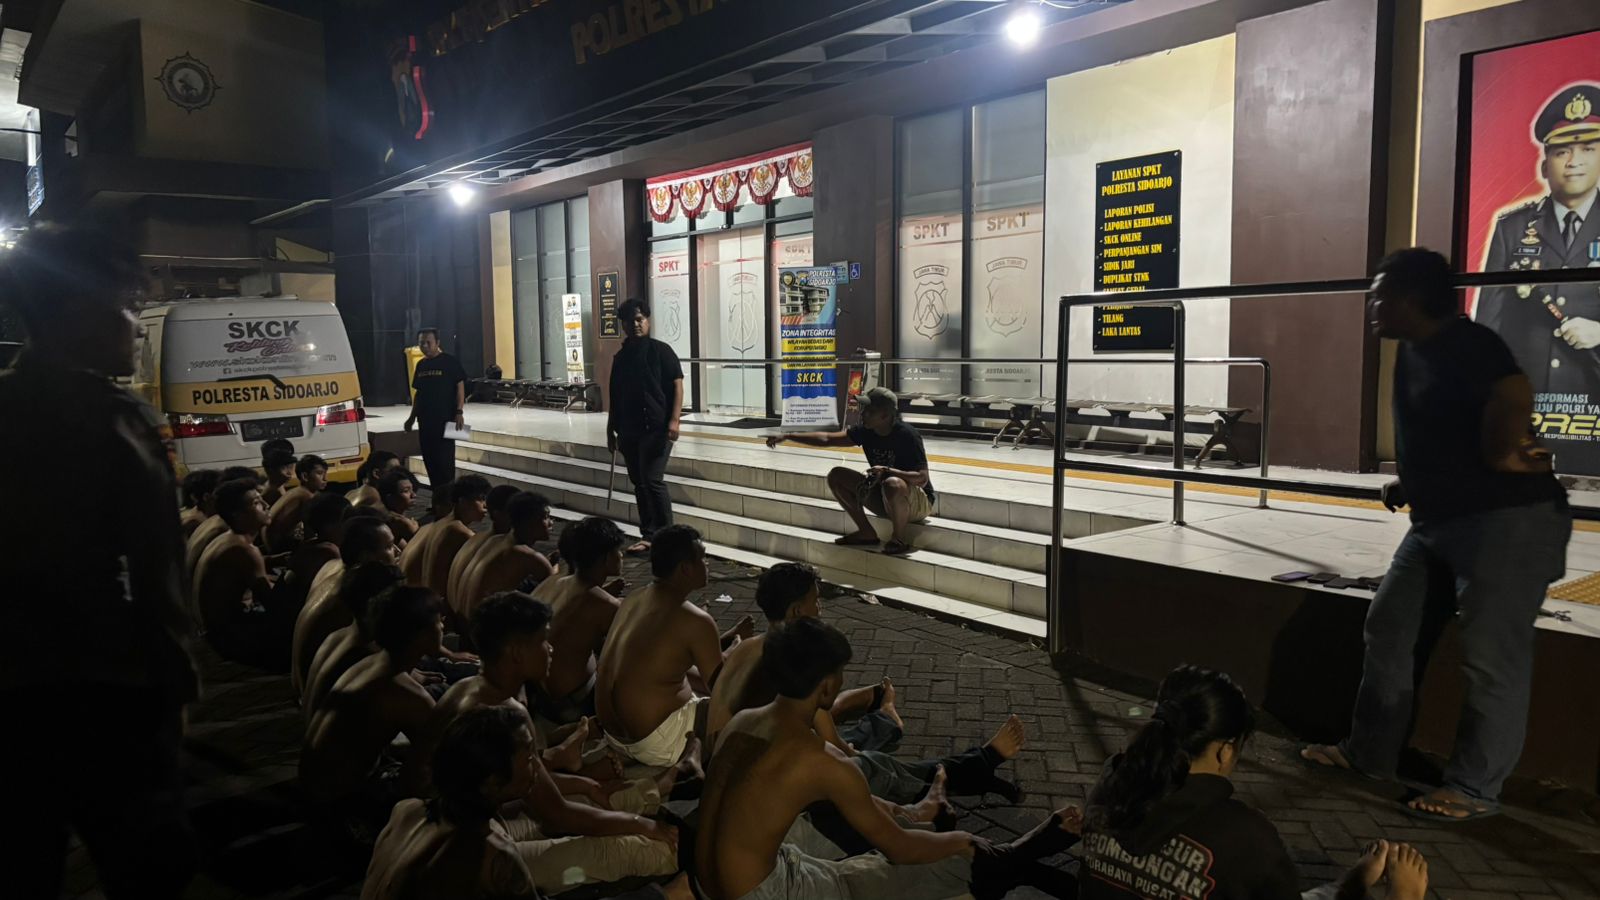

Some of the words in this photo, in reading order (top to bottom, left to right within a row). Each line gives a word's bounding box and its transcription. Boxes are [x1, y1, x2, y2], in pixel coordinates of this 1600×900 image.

[1112, 167, 1142, 182] LAYANAN
[1143, 163, 1162, 177] SPKT
[1101, 182, 1136, 197] POLRESTA
[1138, 176, 1172, 191] SIDOARJO
[1104, 207, 1133, 219] LAPORAN
[1134, 203, 1155, 215] POLISI
[987, 211, 1030, 231] SPKT
[1104, 220, 1133, 233] LAPORAN
[1133, 215, 1172, 230] KEHILANGAN
[914, 222, 950, 240] SPKT
[1104, 235, 1119, 245] SKCK
[1120, 232, 1142, 243] ONLINE
[1103, 245, 1151, 258] PERPANJANGAN
[1151, 243, 1162, 254] SIM
[658, 260, 679, 273] SPKT
[1103, 261, 1120, 272] SIDIK
[1121, 260, 1136, 271] JARI
[1103, 273, 1133, 285] DUPLIKAT
[1134, 272, 1150, 283] STNK
[1102, 315, 1124, 325] TILANG
[228, 320, 300, 339] SKCK
[782, 329, 799, 337] ZONA
[800, 328, 836, 337] INTEGRITAS
[1102, 328, 1118, 338] LAKA
[1119, 327, 1142, 338] LANTAS
[796, 372, 823, 383] SKCK
[192, 386, 270, 406] POLRESTA
[273, 380, 339, 400] SIDOARJO
[1535, 392, 1589, 404] SFORMASI
[1534, 403, 1553, 413] UJU
[1555, 403, 1585, 414] POLRI
[1544, 432, 1592, 442] RESPONSIBILITAS
[1134, 876, 1177, 900] PUSAT
